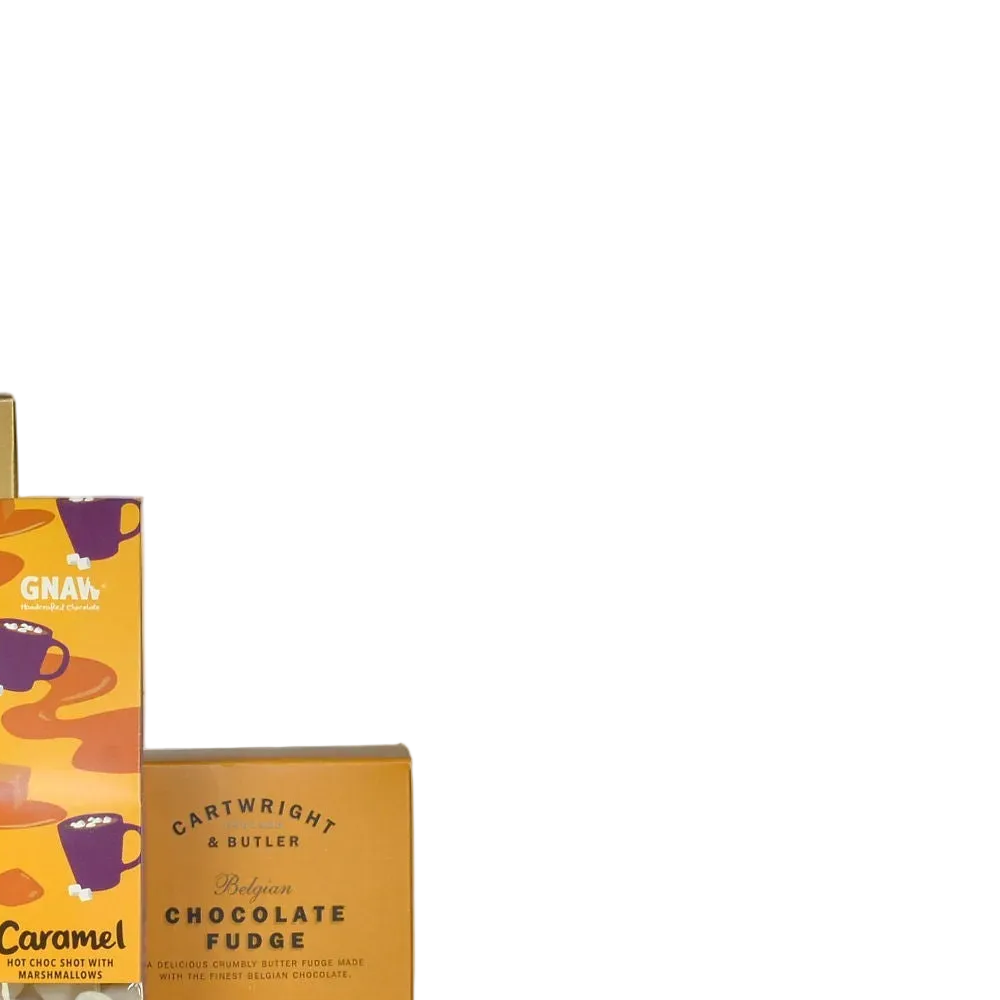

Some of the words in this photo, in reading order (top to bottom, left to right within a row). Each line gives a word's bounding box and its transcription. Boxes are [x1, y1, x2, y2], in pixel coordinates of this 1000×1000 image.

[20, 575, 100, 600] GNAW
[172, 798, 336, 836] CARTWRIGHT
[208, 837, 219, 848] &
[228, 836, 300, 848] BUTLER
[213, 872, 295, 904] Belgian
[165, 905, 345, 925] CHOCOLATE
[206, 932, 305, 950] FUDGE
[7, 959, 26, 967] HOT
[29, 959, 56, 967] CHOC
[60, 959, 85, 967] SHOT
[89, 959, 113, 967] WITH
[157, 961, 208, 969] DELICIOUS
[213, 960, 256, 968] CRUMBLY
[262, 960, 297, 968] BUTTER
[302, 959, 333, 967] FUDGE
[338, 959, 364, 967] MADE
[18, 971, 102, 979] MARSHMALLOWS
[159, 973, 183, 981] WITH
[210, 972, 243, 980] FINEST
[248, 972, 288, 980] BELGIAN
[293, 971, 351, 979] CHOCOLATE.
